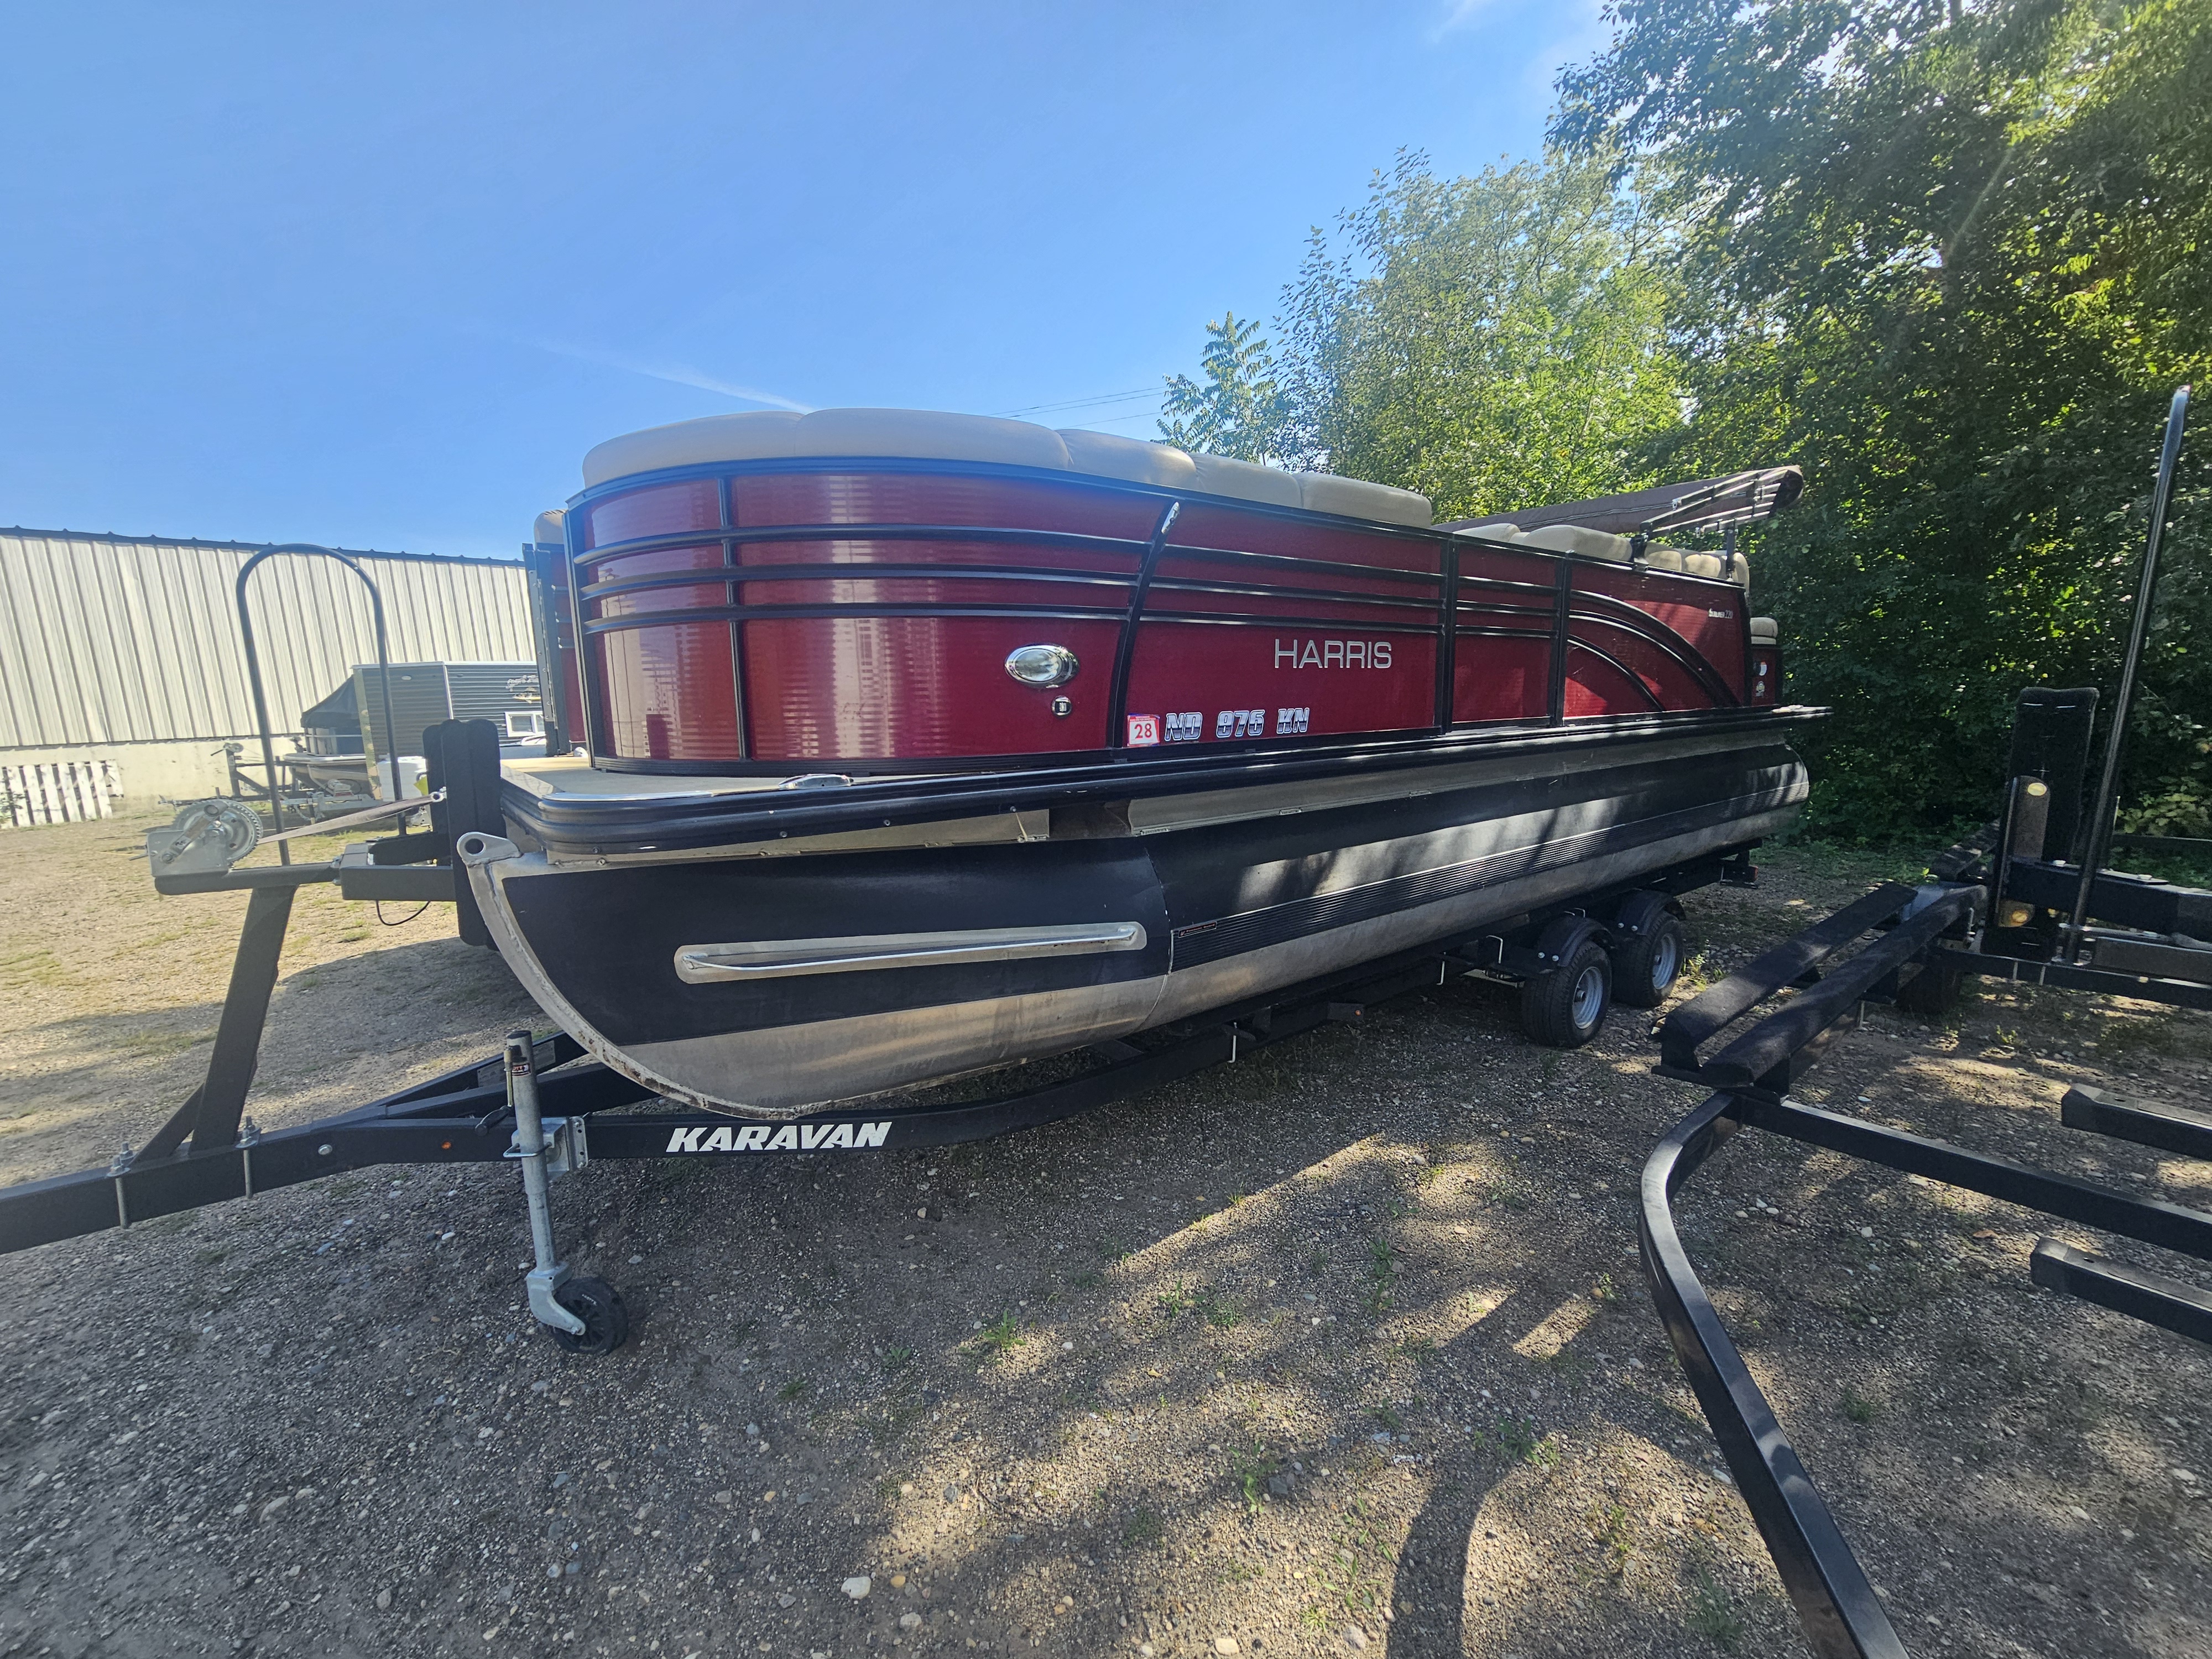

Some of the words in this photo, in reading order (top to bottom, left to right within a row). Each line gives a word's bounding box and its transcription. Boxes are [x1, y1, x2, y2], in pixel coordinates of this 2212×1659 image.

[1275, 639, 1392, 669] HARRIS
[1134, 723, 1152, 739] 28
[1165, 712, 1203, 741] ND
[1216, 709, 1265, 738] 876
[1276, 707, 1310, 734] KN
[666, 1121, 892, 1152] KARAVAN
